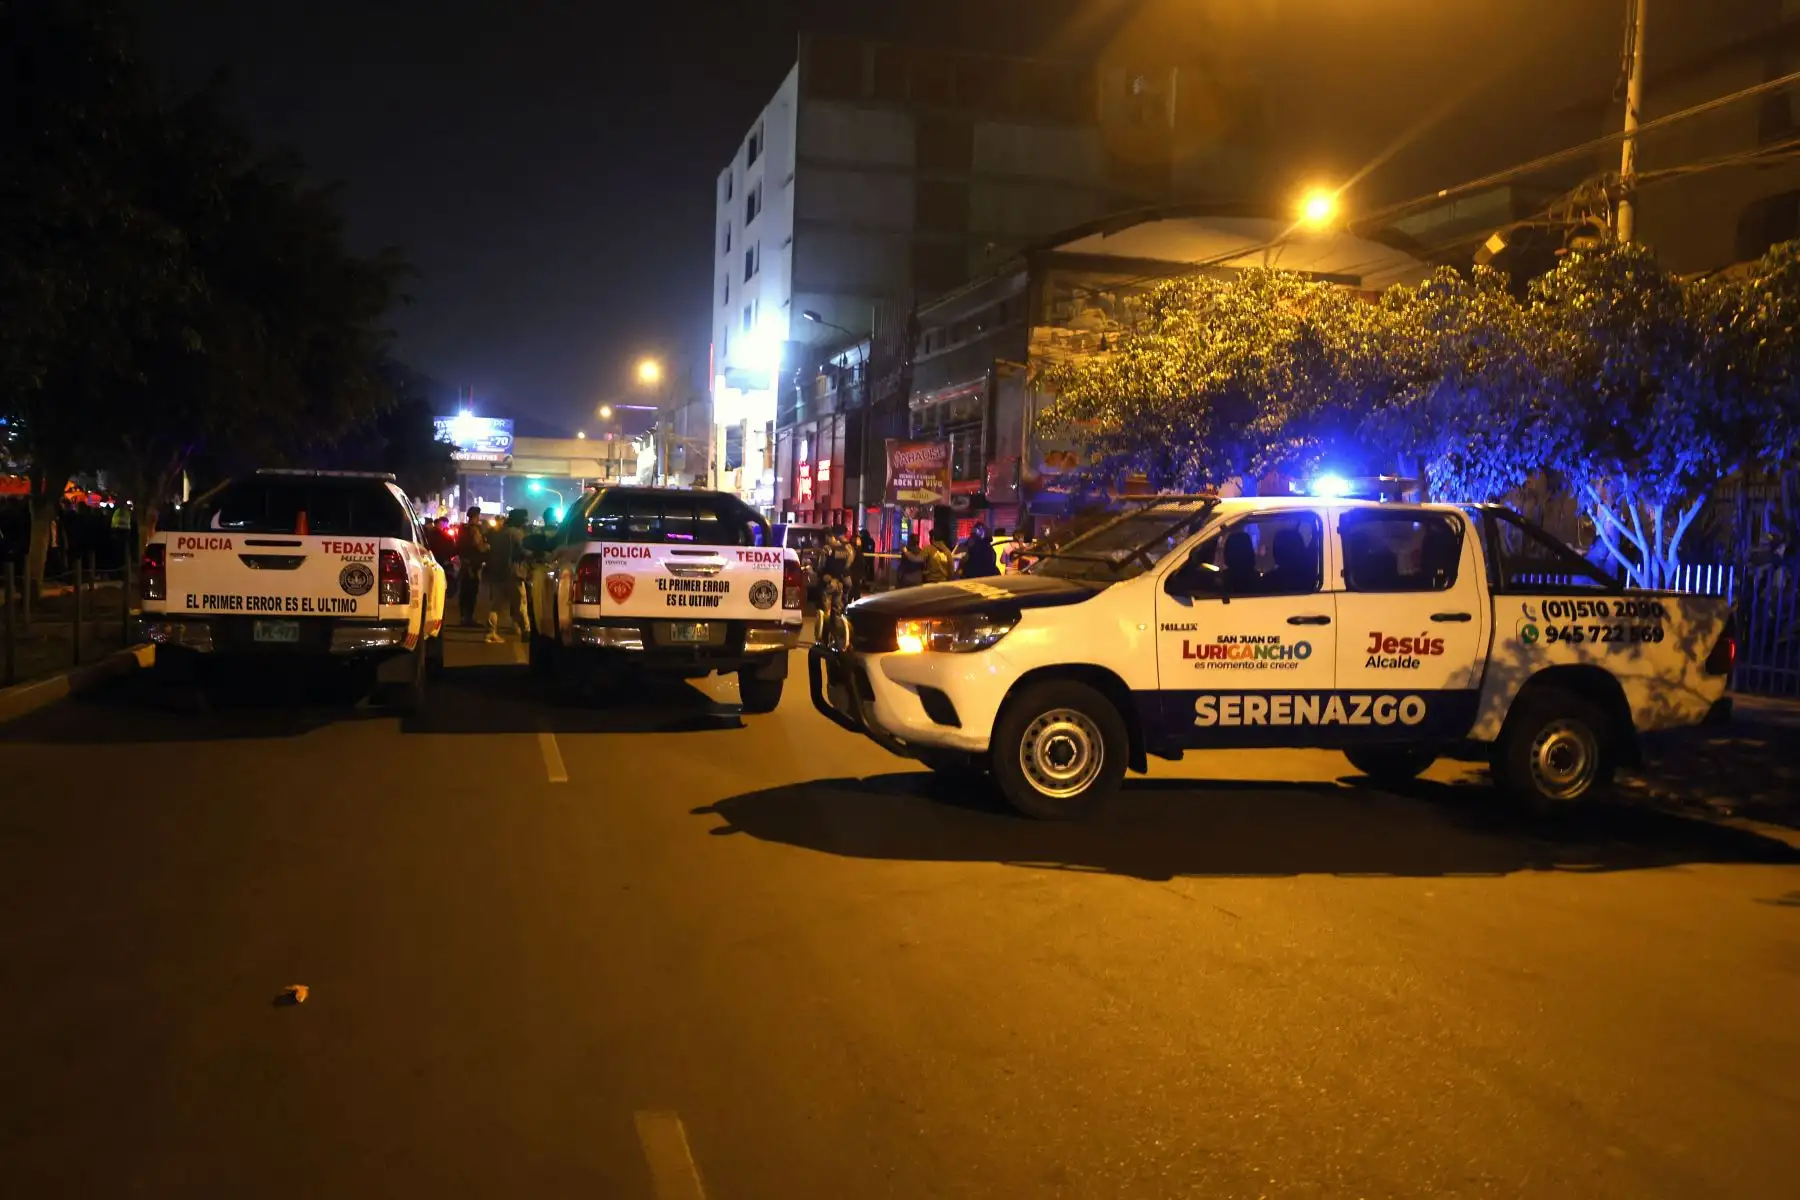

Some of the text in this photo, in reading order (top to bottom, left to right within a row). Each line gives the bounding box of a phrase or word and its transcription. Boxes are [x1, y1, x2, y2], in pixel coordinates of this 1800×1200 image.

[893, 478, 943, 488] ROCK EN VIVO
[177, 537, 233, 550] POLICIA
[321, 541, 376, 555] TEDAX
[603, 547, 651, 558] POLICIA
[736, 551, 781, 563] TEDAX
[669, 579, 701, 592] PRIMER
[703, 580, 730, 593] ERROR
[186, 594, 357, 613] EL PRIMER ERROR ES EL ULTIMO
[666, 594, 677, 606] ES
[678, 595, 688, 607] EL
[1217, 635, 1280, 644] SAN JUAN DE
[1544, 625, 1585, 644] 945
[1587, 625, 1624, 643] 722
[1366, 631, 1445, 656] Jesús
[1194, 659, 1298, 670] es momento de crecer
[1365, 655, 1421, 669] Alcalde
[1193, 694, 1427, 727] SERENAZGO
